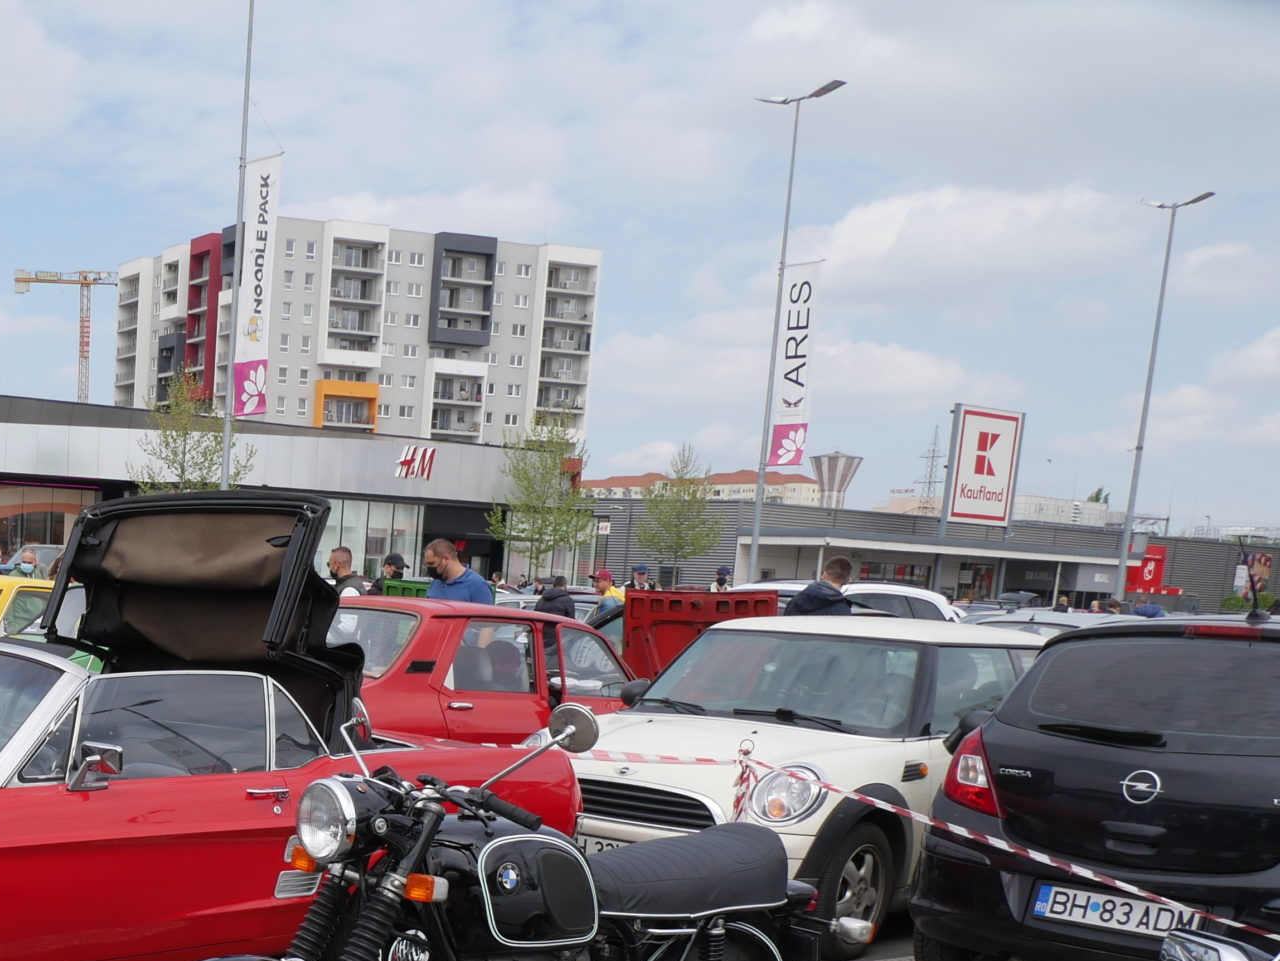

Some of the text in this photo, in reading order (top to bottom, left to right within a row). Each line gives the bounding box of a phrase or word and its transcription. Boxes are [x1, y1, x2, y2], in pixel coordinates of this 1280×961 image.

[253, 174, 270, 315] NOODLE PACK
[783, 280, 812, 388] ARES
[394, 444, 437, 481] H&M
[960, 483, 1004, 503] Kaufland
[999, 767, 1032, 778] CORSA
[1035, 901, 1048, 912] RO
[1049, 890, 1196, 932] BH 83 ADM
